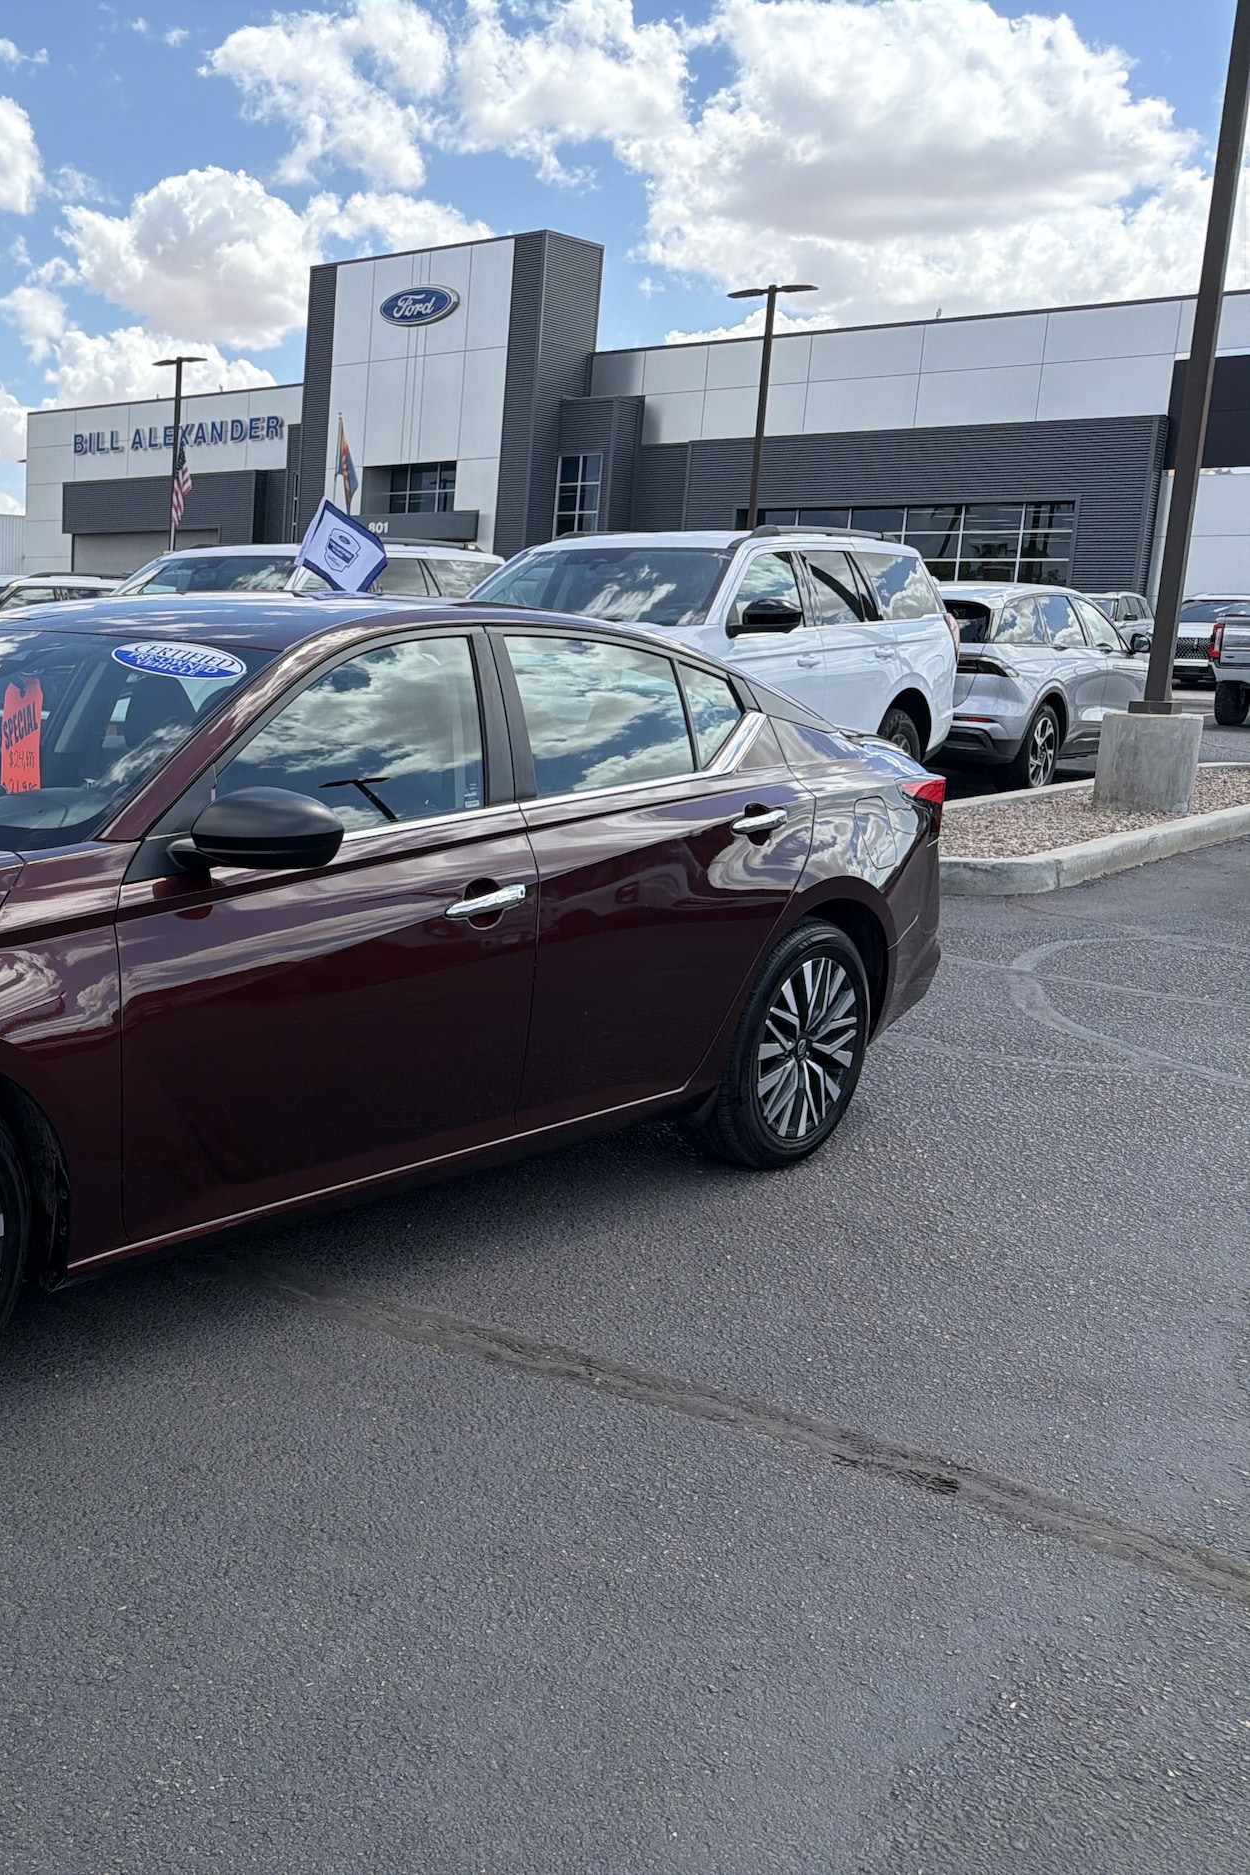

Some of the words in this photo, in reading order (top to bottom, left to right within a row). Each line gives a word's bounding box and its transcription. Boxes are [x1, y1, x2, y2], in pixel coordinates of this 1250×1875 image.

[393, 294, 437, 318] Ford
[73, 431, 122, 455] BILL
[131, 415, 285, 450] ALEXANDER
[368, 522, 389, 534] 801
[128, 651, 219, 674] PRE-OWNED
[134, 644, 236, 669] CERTIFIED
[135, 658, 197, 677] VEHICLE
[2, 701, 39, 751] SPECIAL
